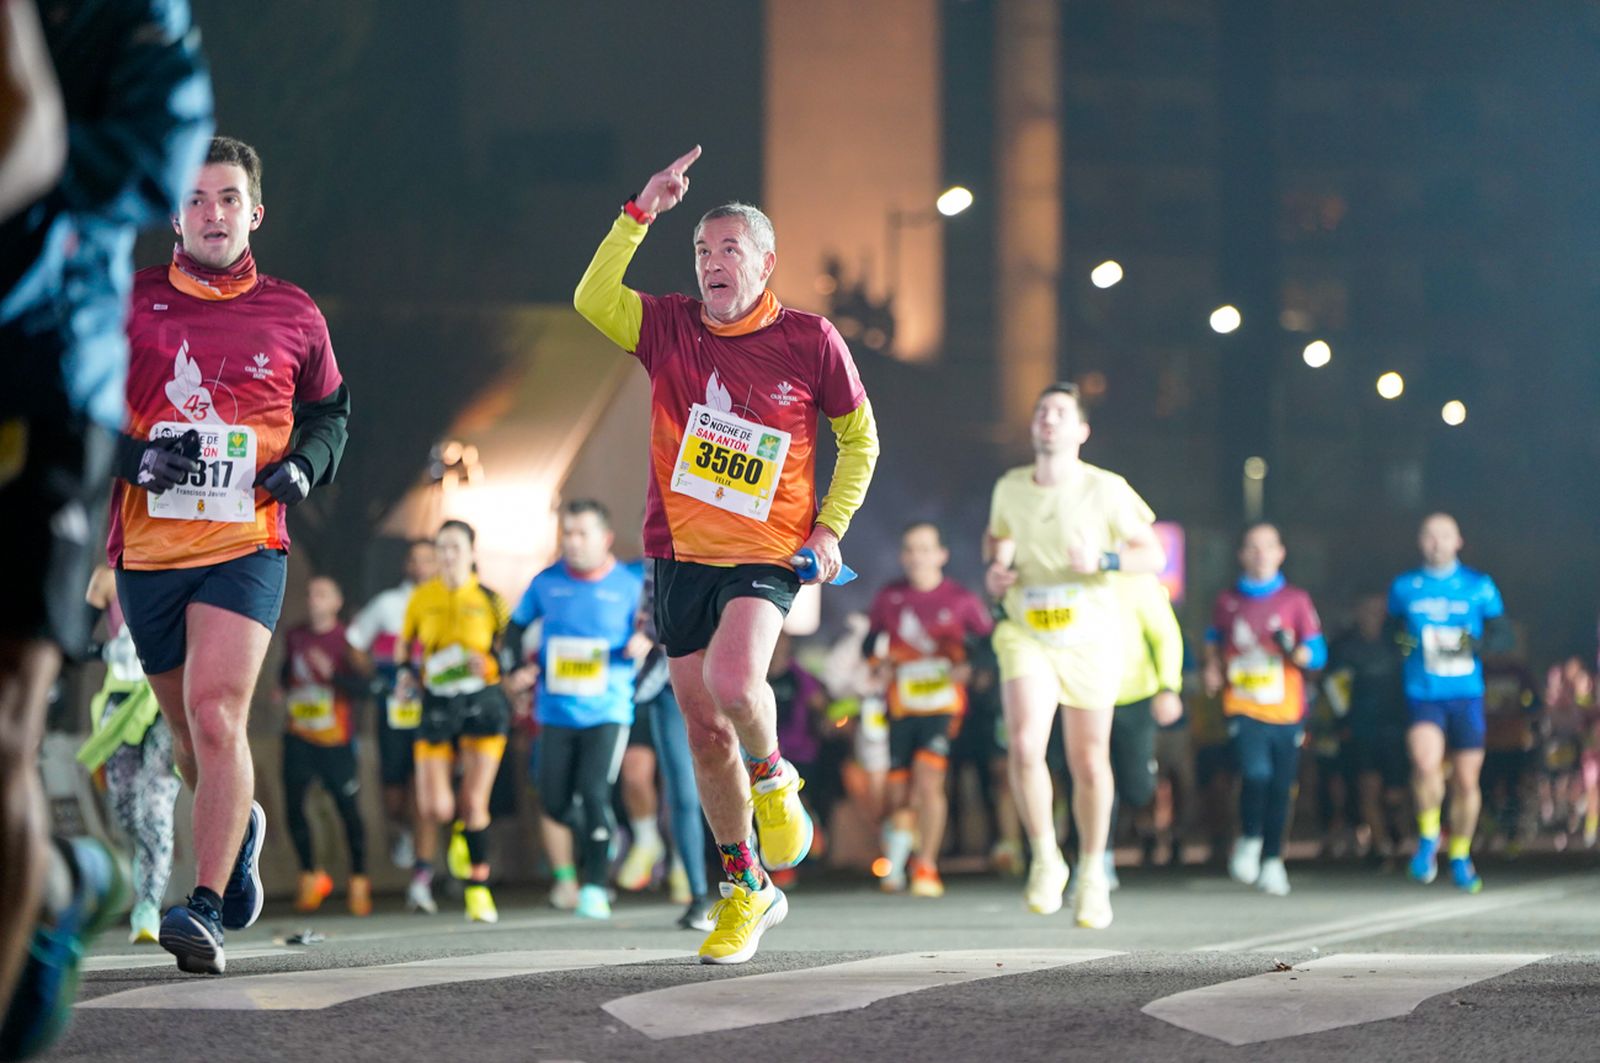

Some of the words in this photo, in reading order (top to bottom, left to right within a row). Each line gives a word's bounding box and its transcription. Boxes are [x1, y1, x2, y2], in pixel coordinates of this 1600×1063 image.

[183, 394, 210, 421] 43
[695, 427, 716, 442] SAN
[709, 421, 739, 438] NOCHE
[739, 431, 753, 441] DE
[206, 436, 219, 445] DE
[695, 441, 764, 485] 3560
[176, 487, 207, 497] Francisco
